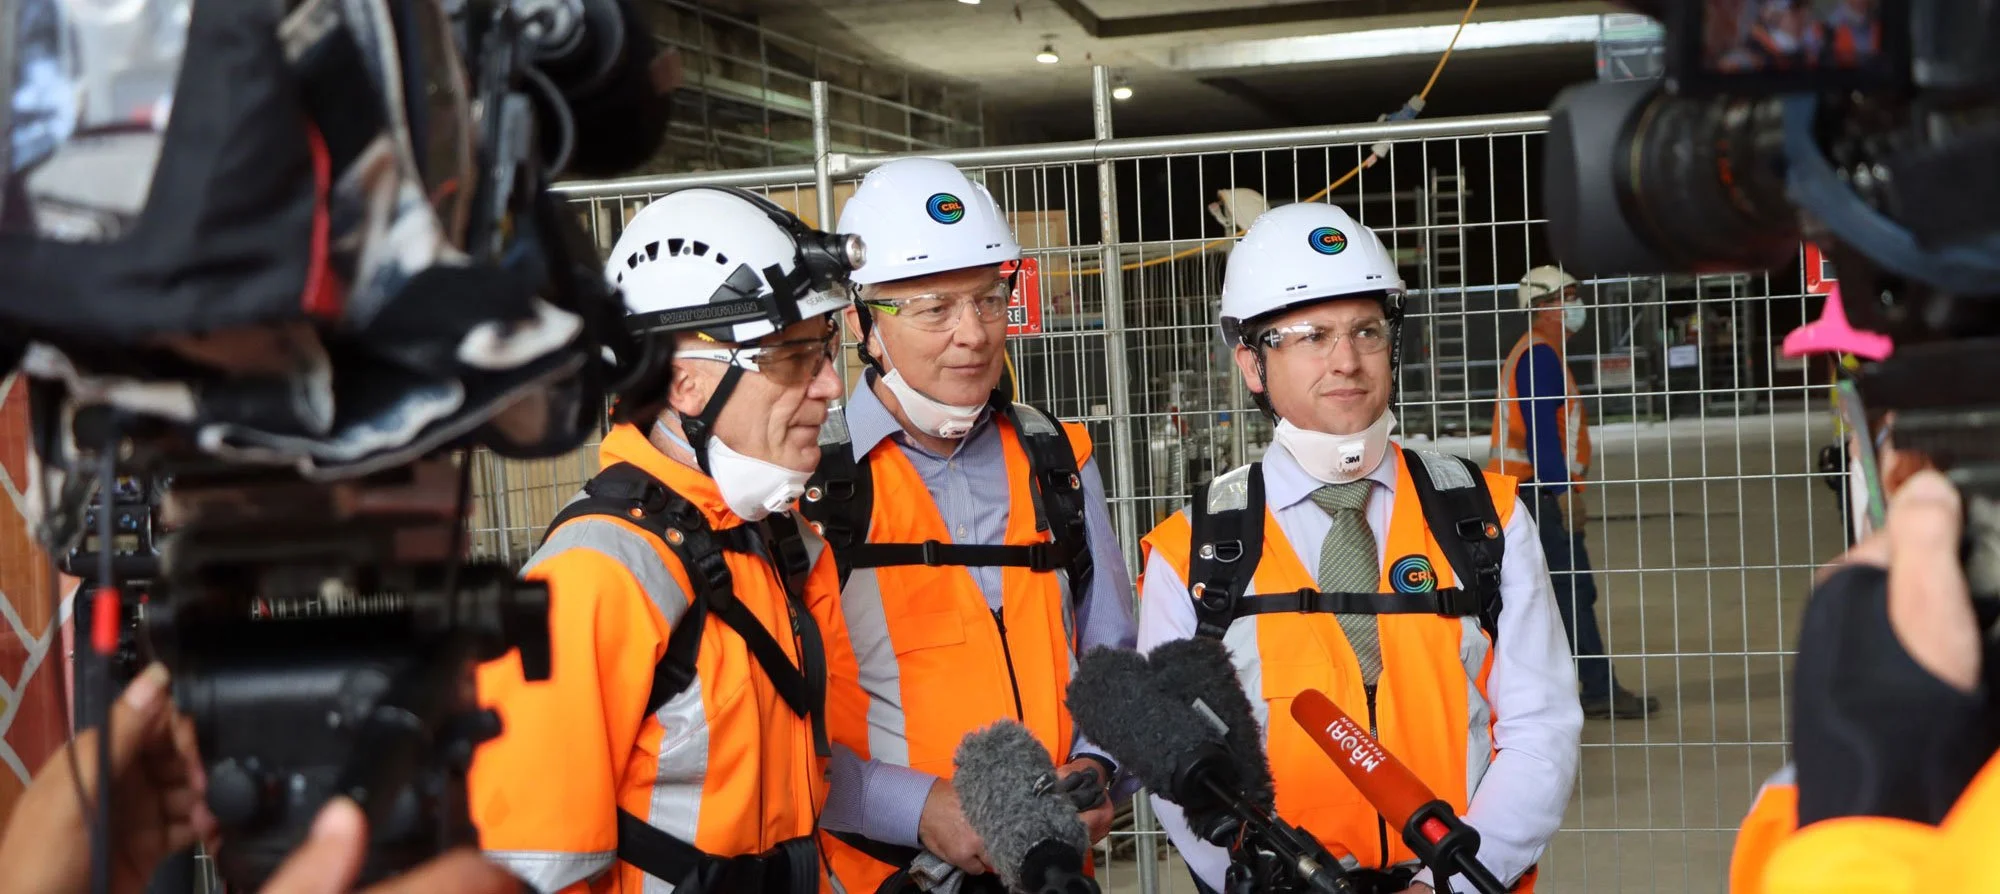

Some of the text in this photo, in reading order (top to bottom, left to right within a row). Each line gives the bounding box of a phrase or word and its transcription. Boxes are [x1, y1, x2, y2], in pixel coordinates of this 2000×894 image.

[941, 202, 962, 211] CRL
[1323, 234, 1345, 243] CRL
[659, 301, 758, 324] WATCHMAN
[1345, 455, 1360, 464] 3M
[1408, 571, 1434, 582] CRL
[1340, 716, 1386, 761] TELEVISION
